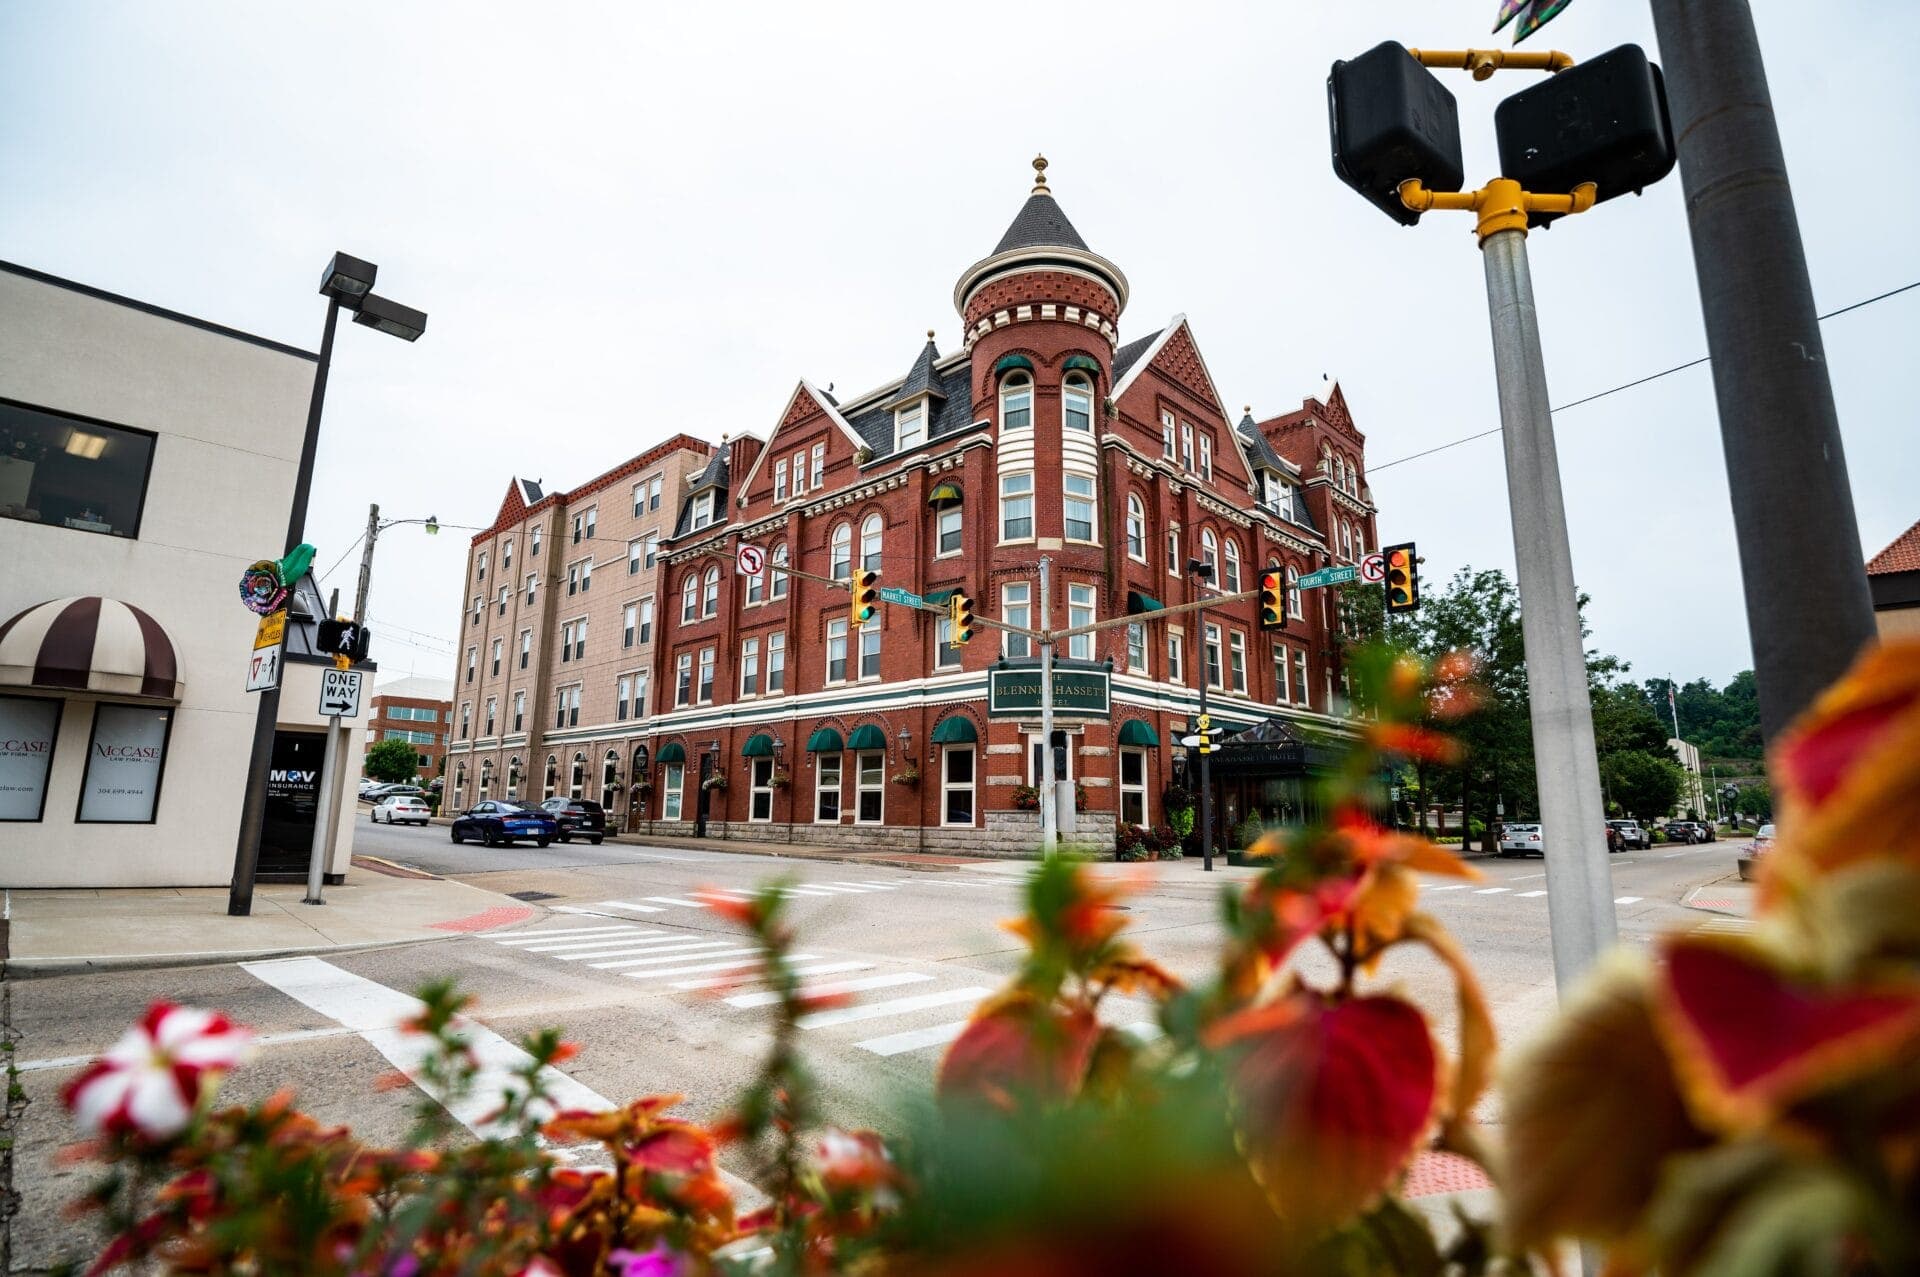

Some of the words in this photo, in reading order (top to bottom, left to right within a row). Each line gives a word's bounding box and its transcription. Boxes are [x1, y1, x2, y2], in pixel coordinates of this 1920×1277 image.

[1300, 576, 1322, 587] FOURTH
[1330, 569, 1352, 582] STREET
[882, 590, 902, 603] MARKET
[903, 595, 921, 607] STREET
[328, 673, 357, 686] ONE
[326, 686, 356, 698] WAY
[996, 685, 1106, 697] BLENNHASSETT
